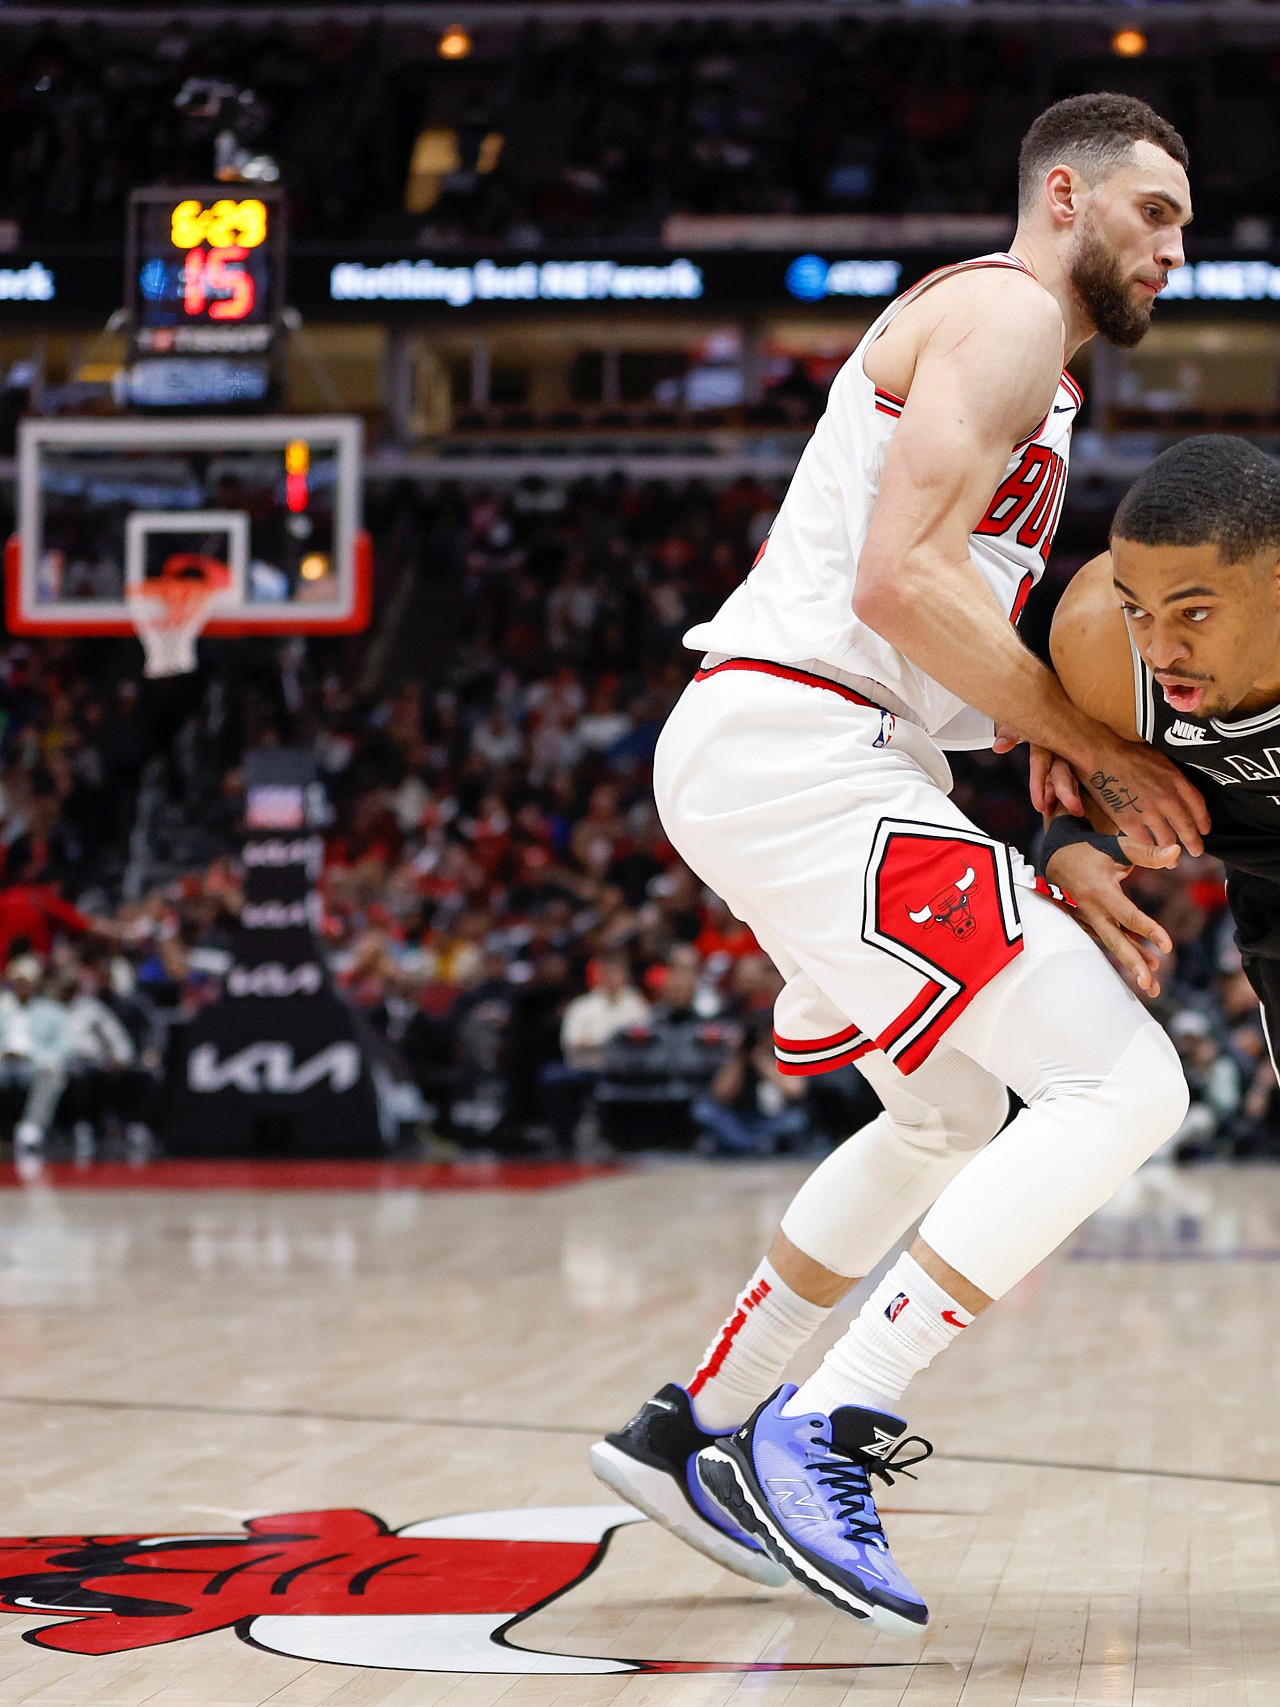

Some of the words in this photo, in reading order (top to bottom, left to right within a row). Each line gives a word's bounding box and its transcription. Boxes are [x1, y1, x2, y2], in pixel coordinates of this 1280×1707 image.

[184, 247, 255, 320] 15
[330, 260, 473, 307] Nothing
[473, 258, 538, 299] but
[538, 258, 703, 299] NETwork
[1172, 719, 1207, 741] NIKE
